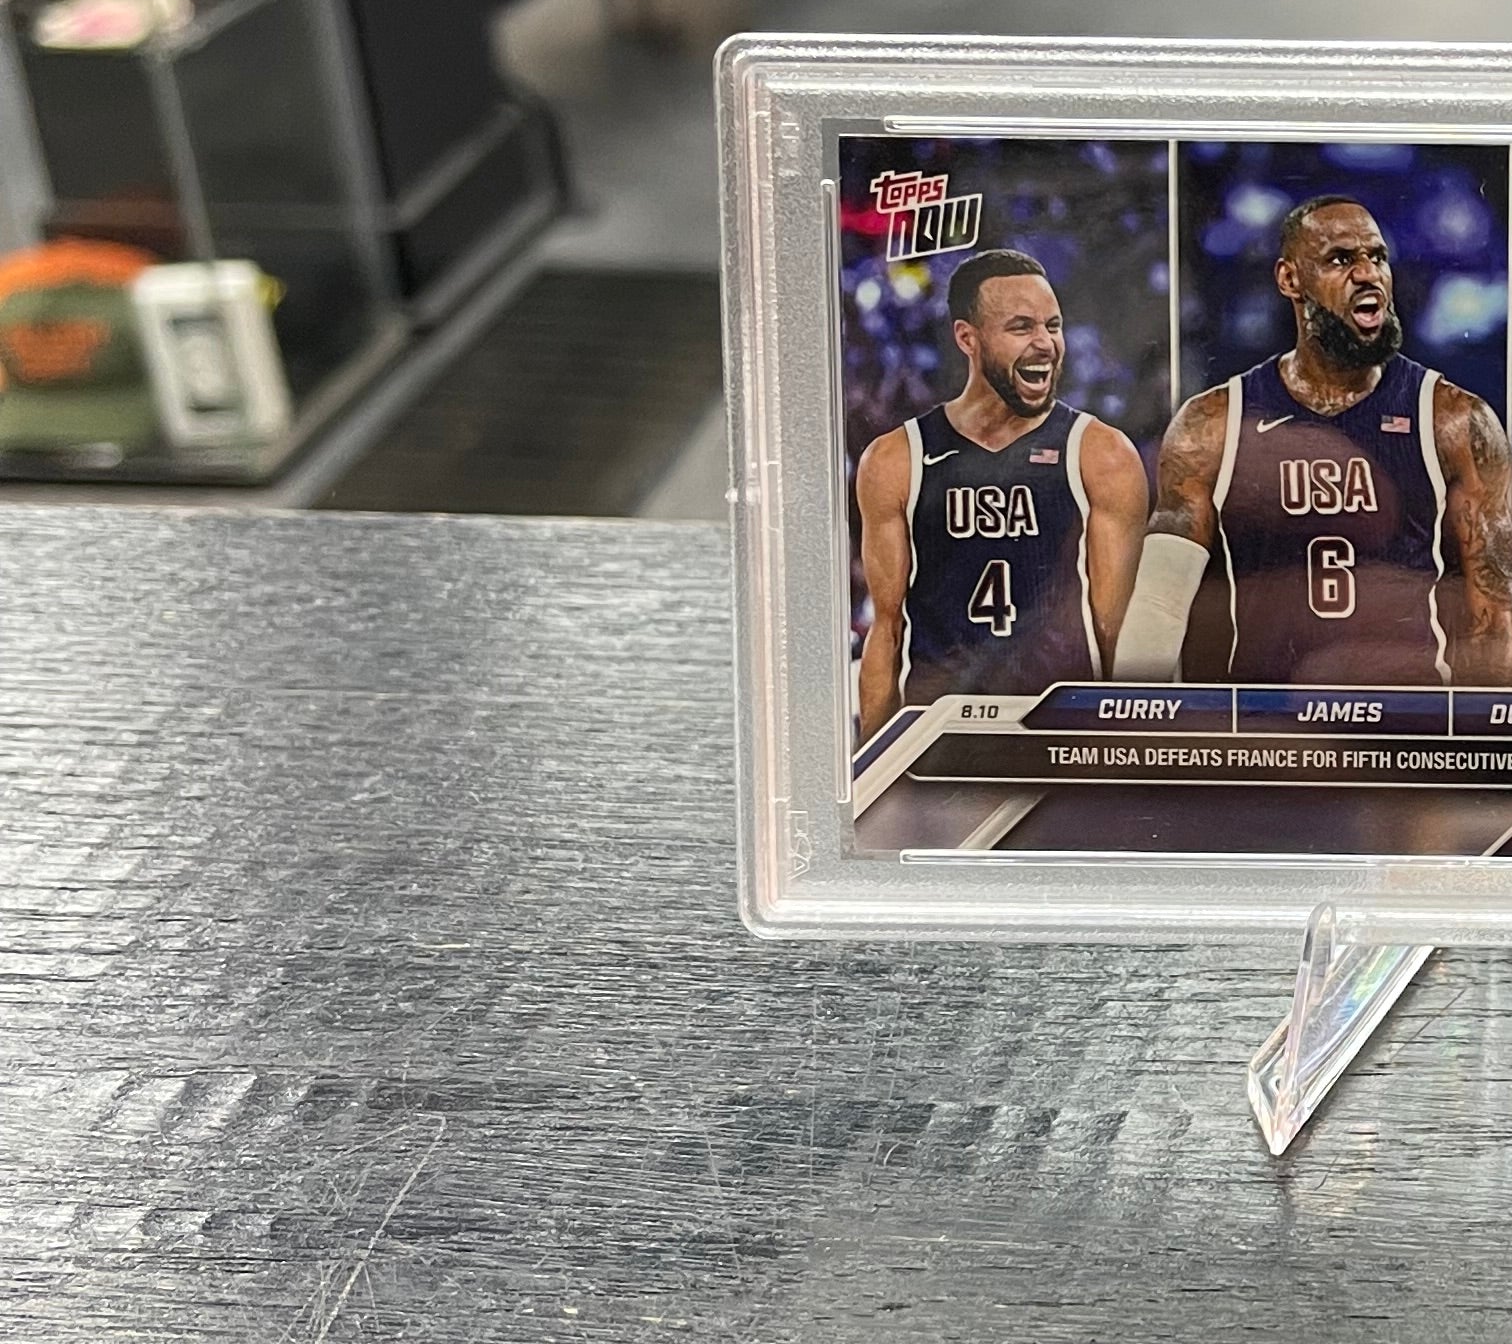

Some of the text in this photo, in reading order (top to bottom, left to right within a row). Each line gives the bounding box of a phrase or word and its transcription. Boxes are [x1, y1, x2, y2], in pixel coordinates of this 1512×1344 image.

[1280, 458, 1378, 515] USA
[946, 485, 1039, 538] USA
[1307, 536, 1356, 619] 6
[968, 559, 1017, 637] 4
[961, 704, 999, 719] 8.10
[1098, 699, 1181, 720] CURRY
[1297, 701, 1383, 723] JAMES
[1048, 746, 1098, 765] TEAM
[1104, 747, 1139, 766] USA
[1145, 748, 1222, 767] DEFEATS
[1227, 749, 1297, 768] FRANCE
[1302, 750, 1337, 768] FOR
[1343, 751, 1391, 769] FIFTH
